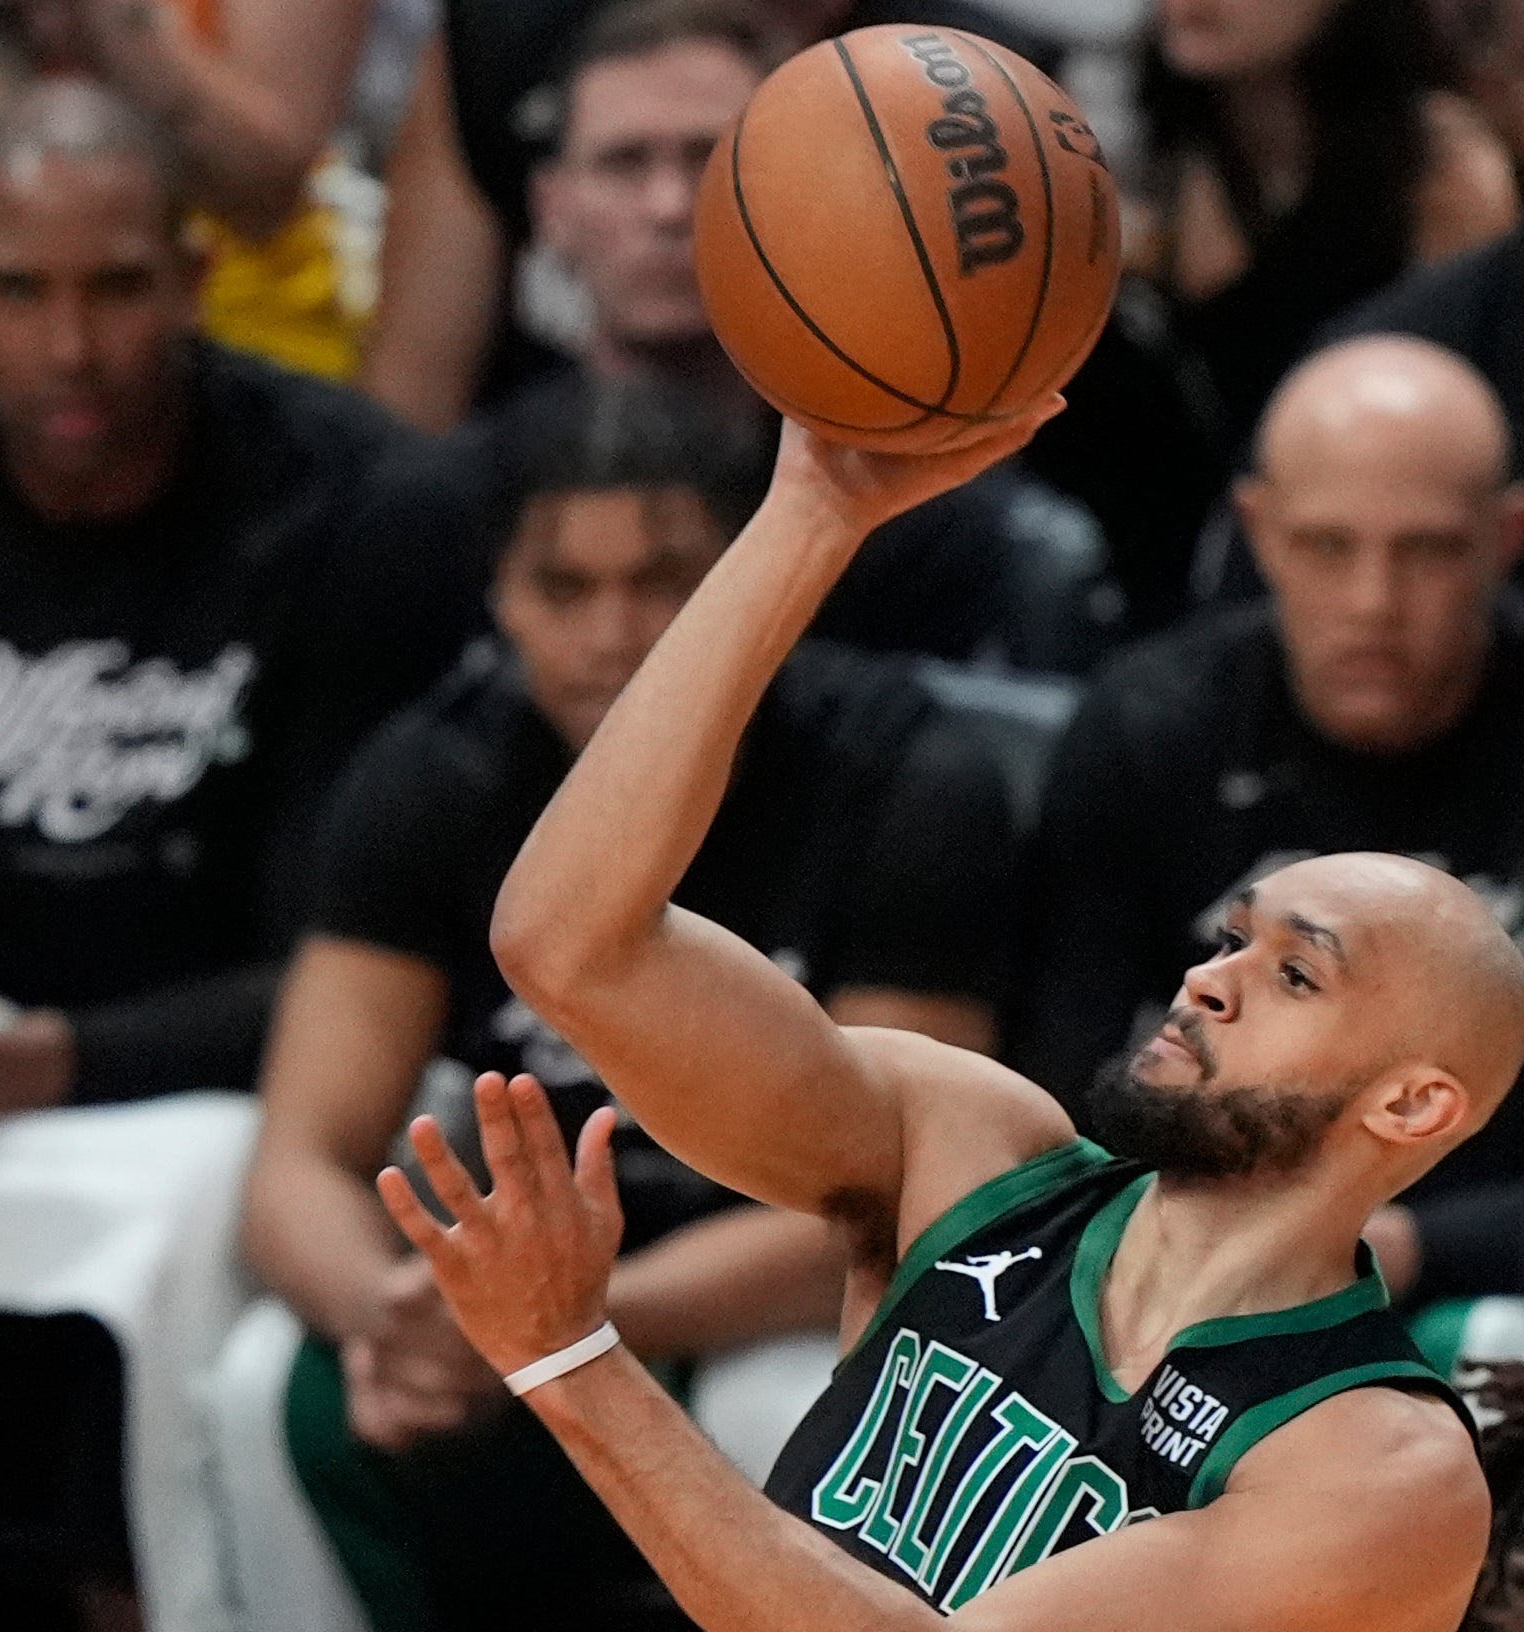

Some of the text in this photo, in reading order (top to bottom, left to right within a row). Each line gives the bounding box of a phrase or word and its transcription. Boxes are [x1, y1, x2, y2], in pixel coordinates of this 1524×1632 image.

[899, 31, 1026, 281] Wilson
[811, 1327, 1162, 1617] CELTIC
[1139, 1397, 1207, 1468] PRINT
[1152, 1363, 1229, 1443] VISTA
